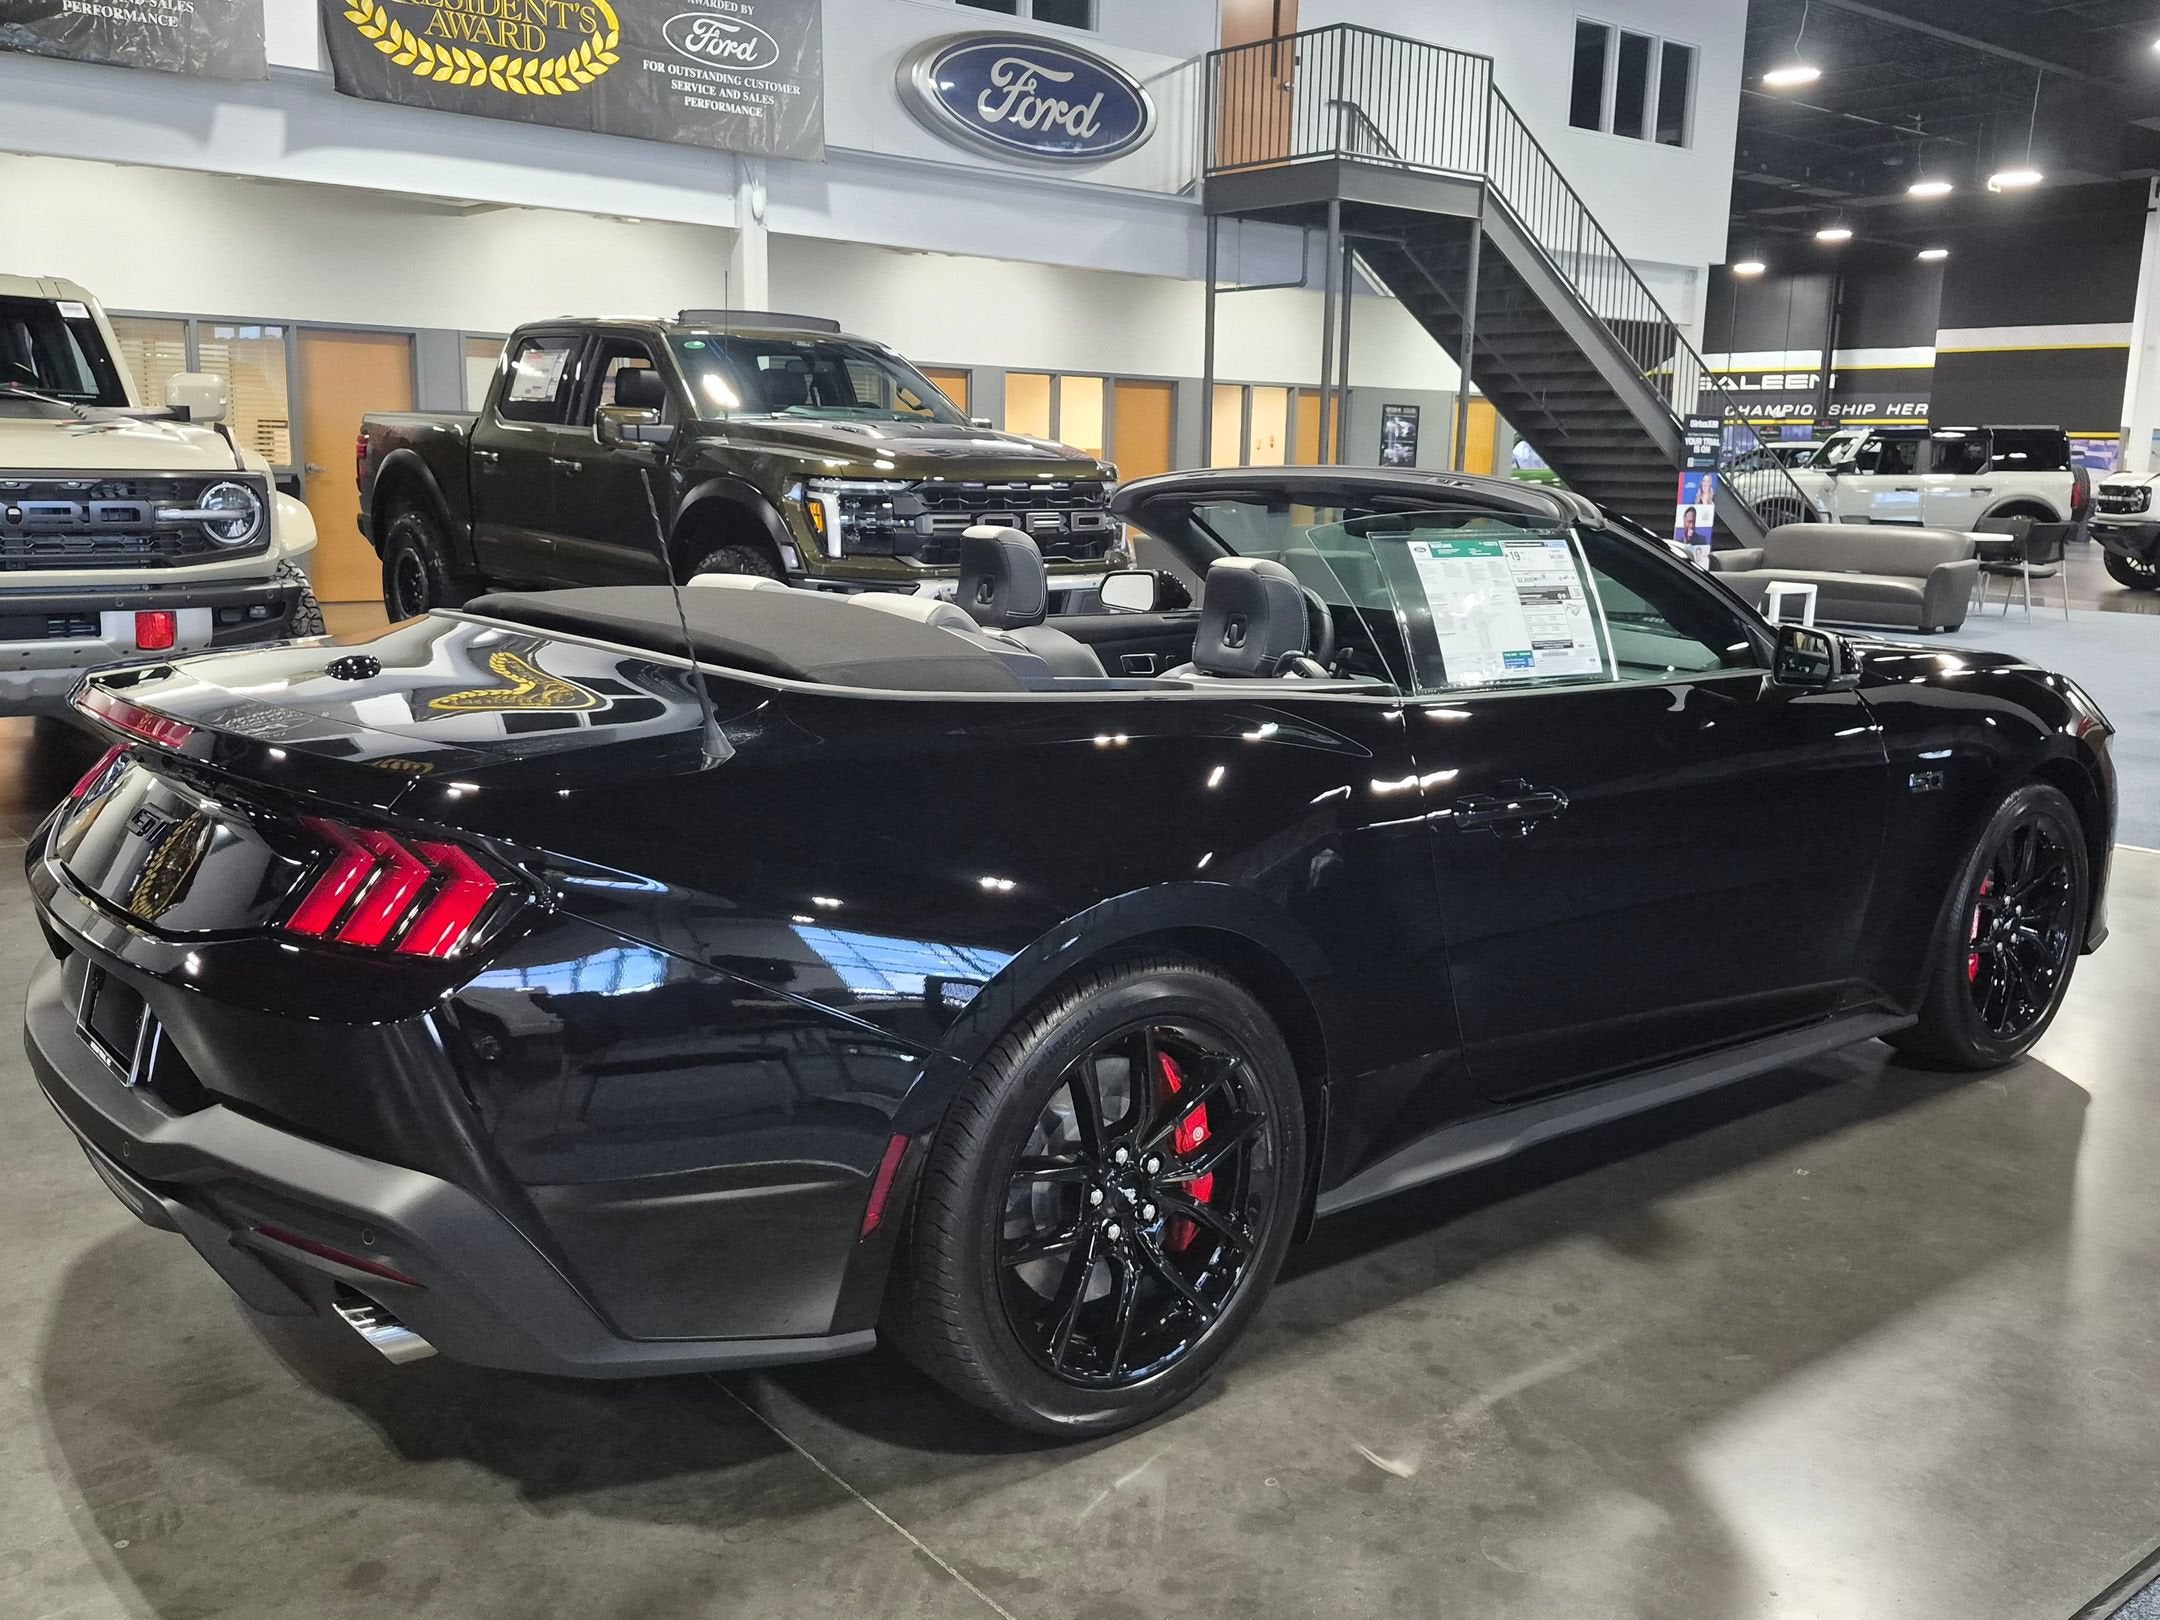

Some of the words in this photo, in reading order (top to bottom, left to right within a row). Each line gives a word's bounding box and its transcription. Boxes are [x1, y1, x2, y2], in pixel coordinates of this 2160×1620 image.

[62, 0, 179, 28] PERFORMANCE
[149, 0, 195, 14] SALES
[411, 0, 598, 34] DENT'S
[740, 4, 755, 16] BY
[424, 8, 547, 52] AWARD
[685, 18, 758, 62] Ford
[643, 59, 666, 73] FOR
[667, 64, 742, 86] OUTSTANDING
[744, 78, 801, 96] CUSTOMER
[671, 79, 717, 97] SERVICE
[719, 87, 741, 101] AND
[743, 91, 775, 106] SALES
[977, 57, 1105, 139] Ford
[684, 96, 764, 118] PERFORMANCE
[1724, 404, 1877, 417] CHAMPIOSHIP
[1885, 403, 1929, 416] HER
[914, 512, 1107, 536] FORD
